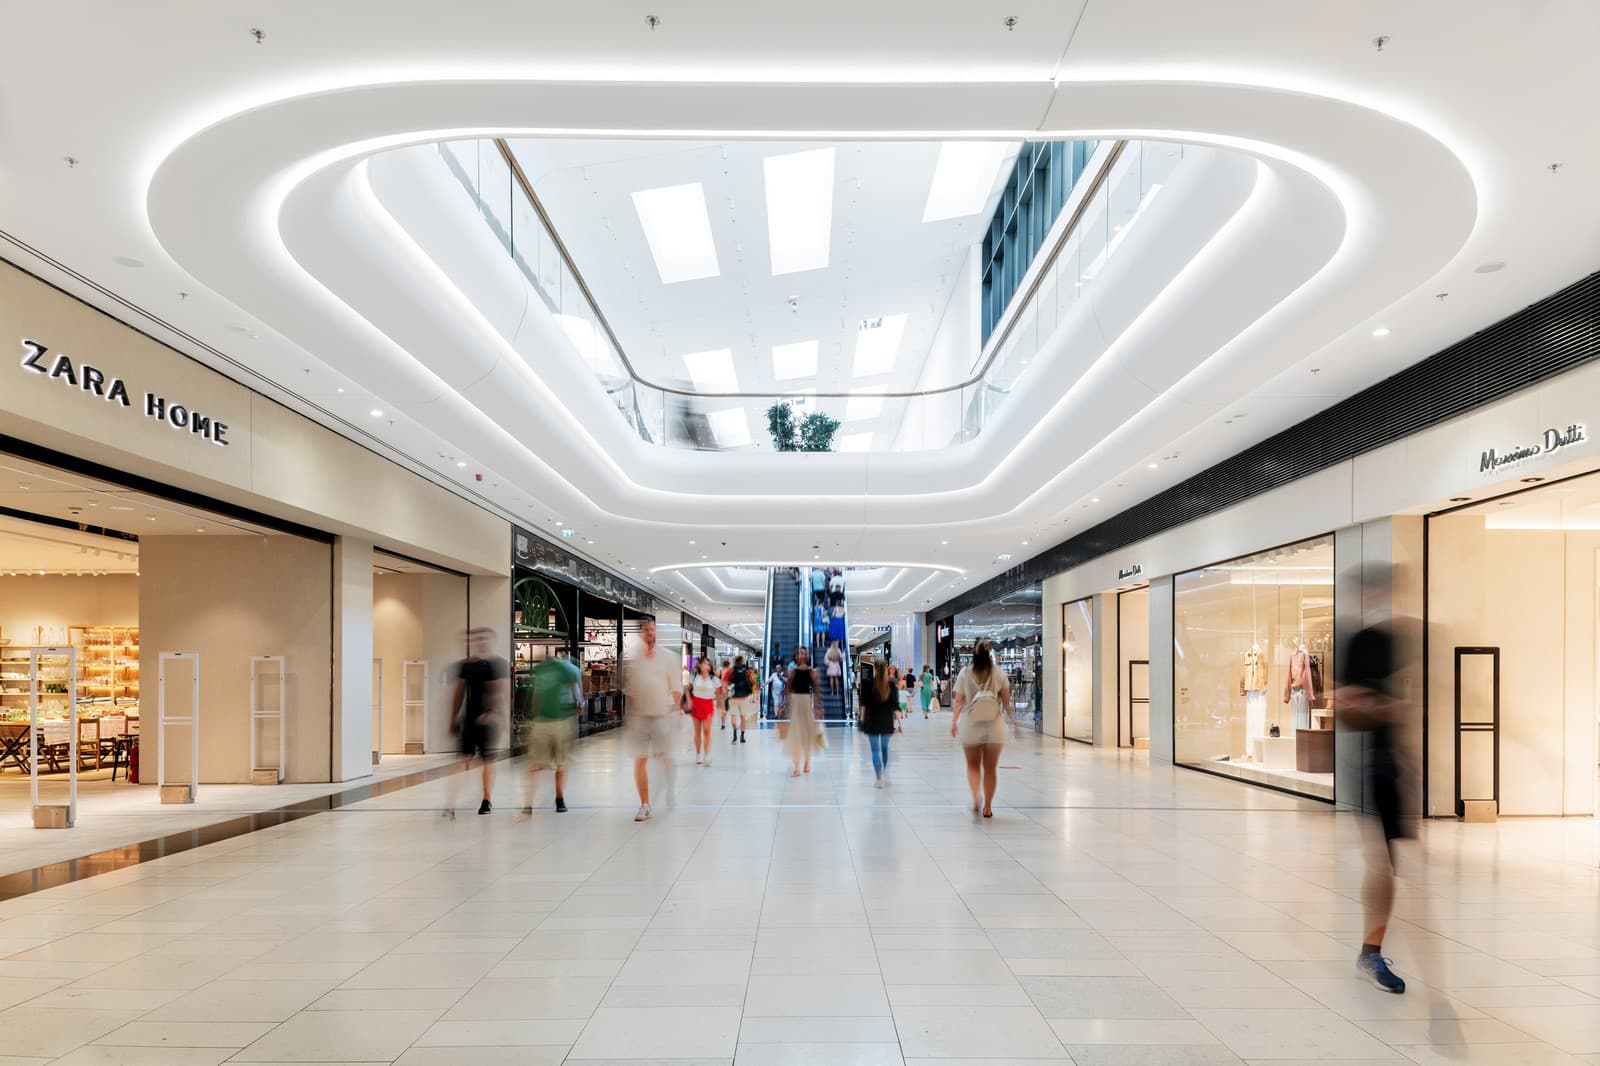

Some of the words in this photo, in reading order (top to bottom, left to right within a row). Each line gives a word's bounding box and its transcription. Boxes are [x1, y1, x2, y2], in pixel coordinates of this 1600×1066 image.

[21, 339, 131, 407] ZARA
[145, 392, 230, 446] HOME
[1479, 446, 1541, 473] Massimo
[1543, 424, 1585, 454] Dutti
